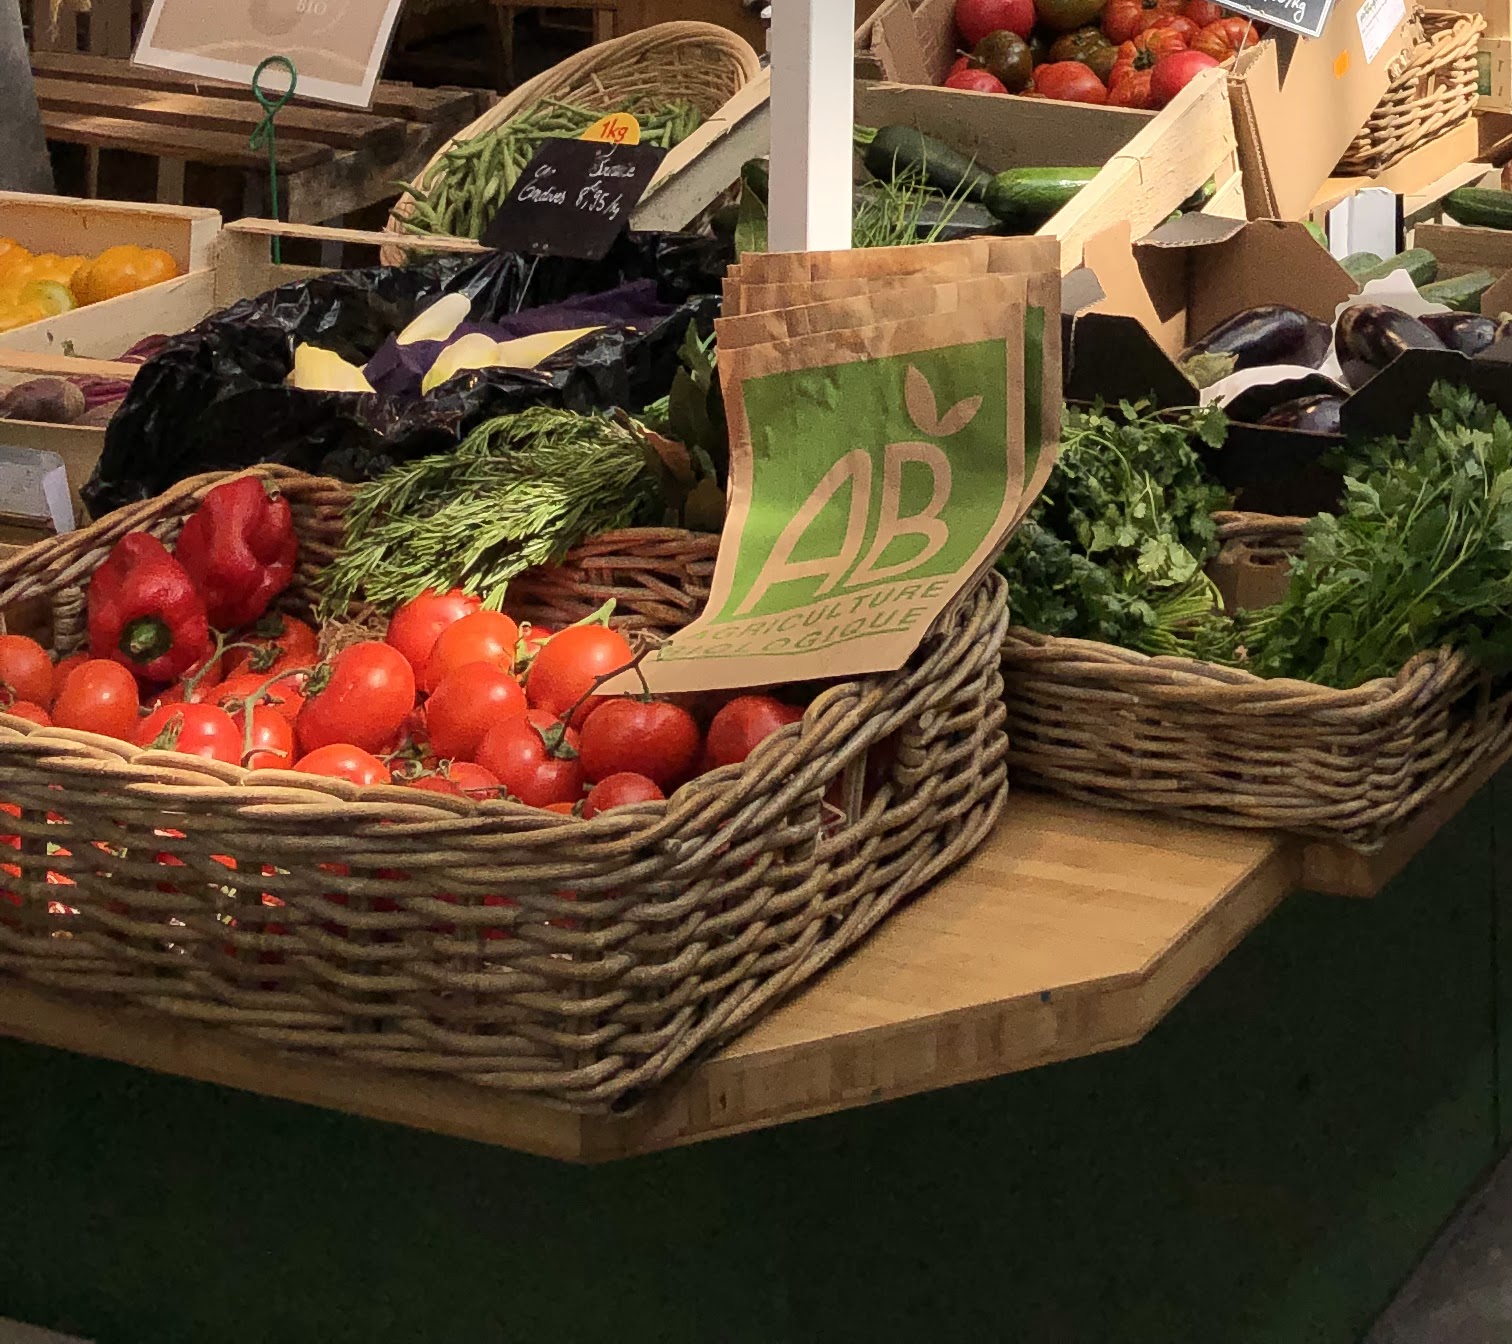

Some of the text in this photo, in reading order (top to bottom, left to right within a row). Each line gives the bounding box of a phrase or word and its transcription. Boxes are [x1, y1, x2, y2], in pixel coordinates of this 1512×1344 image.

[600, 118, 629, 142] 1kg
[733, 441, 953, 616] AB
[687, 579, 950, 641] AGRICULTURE
